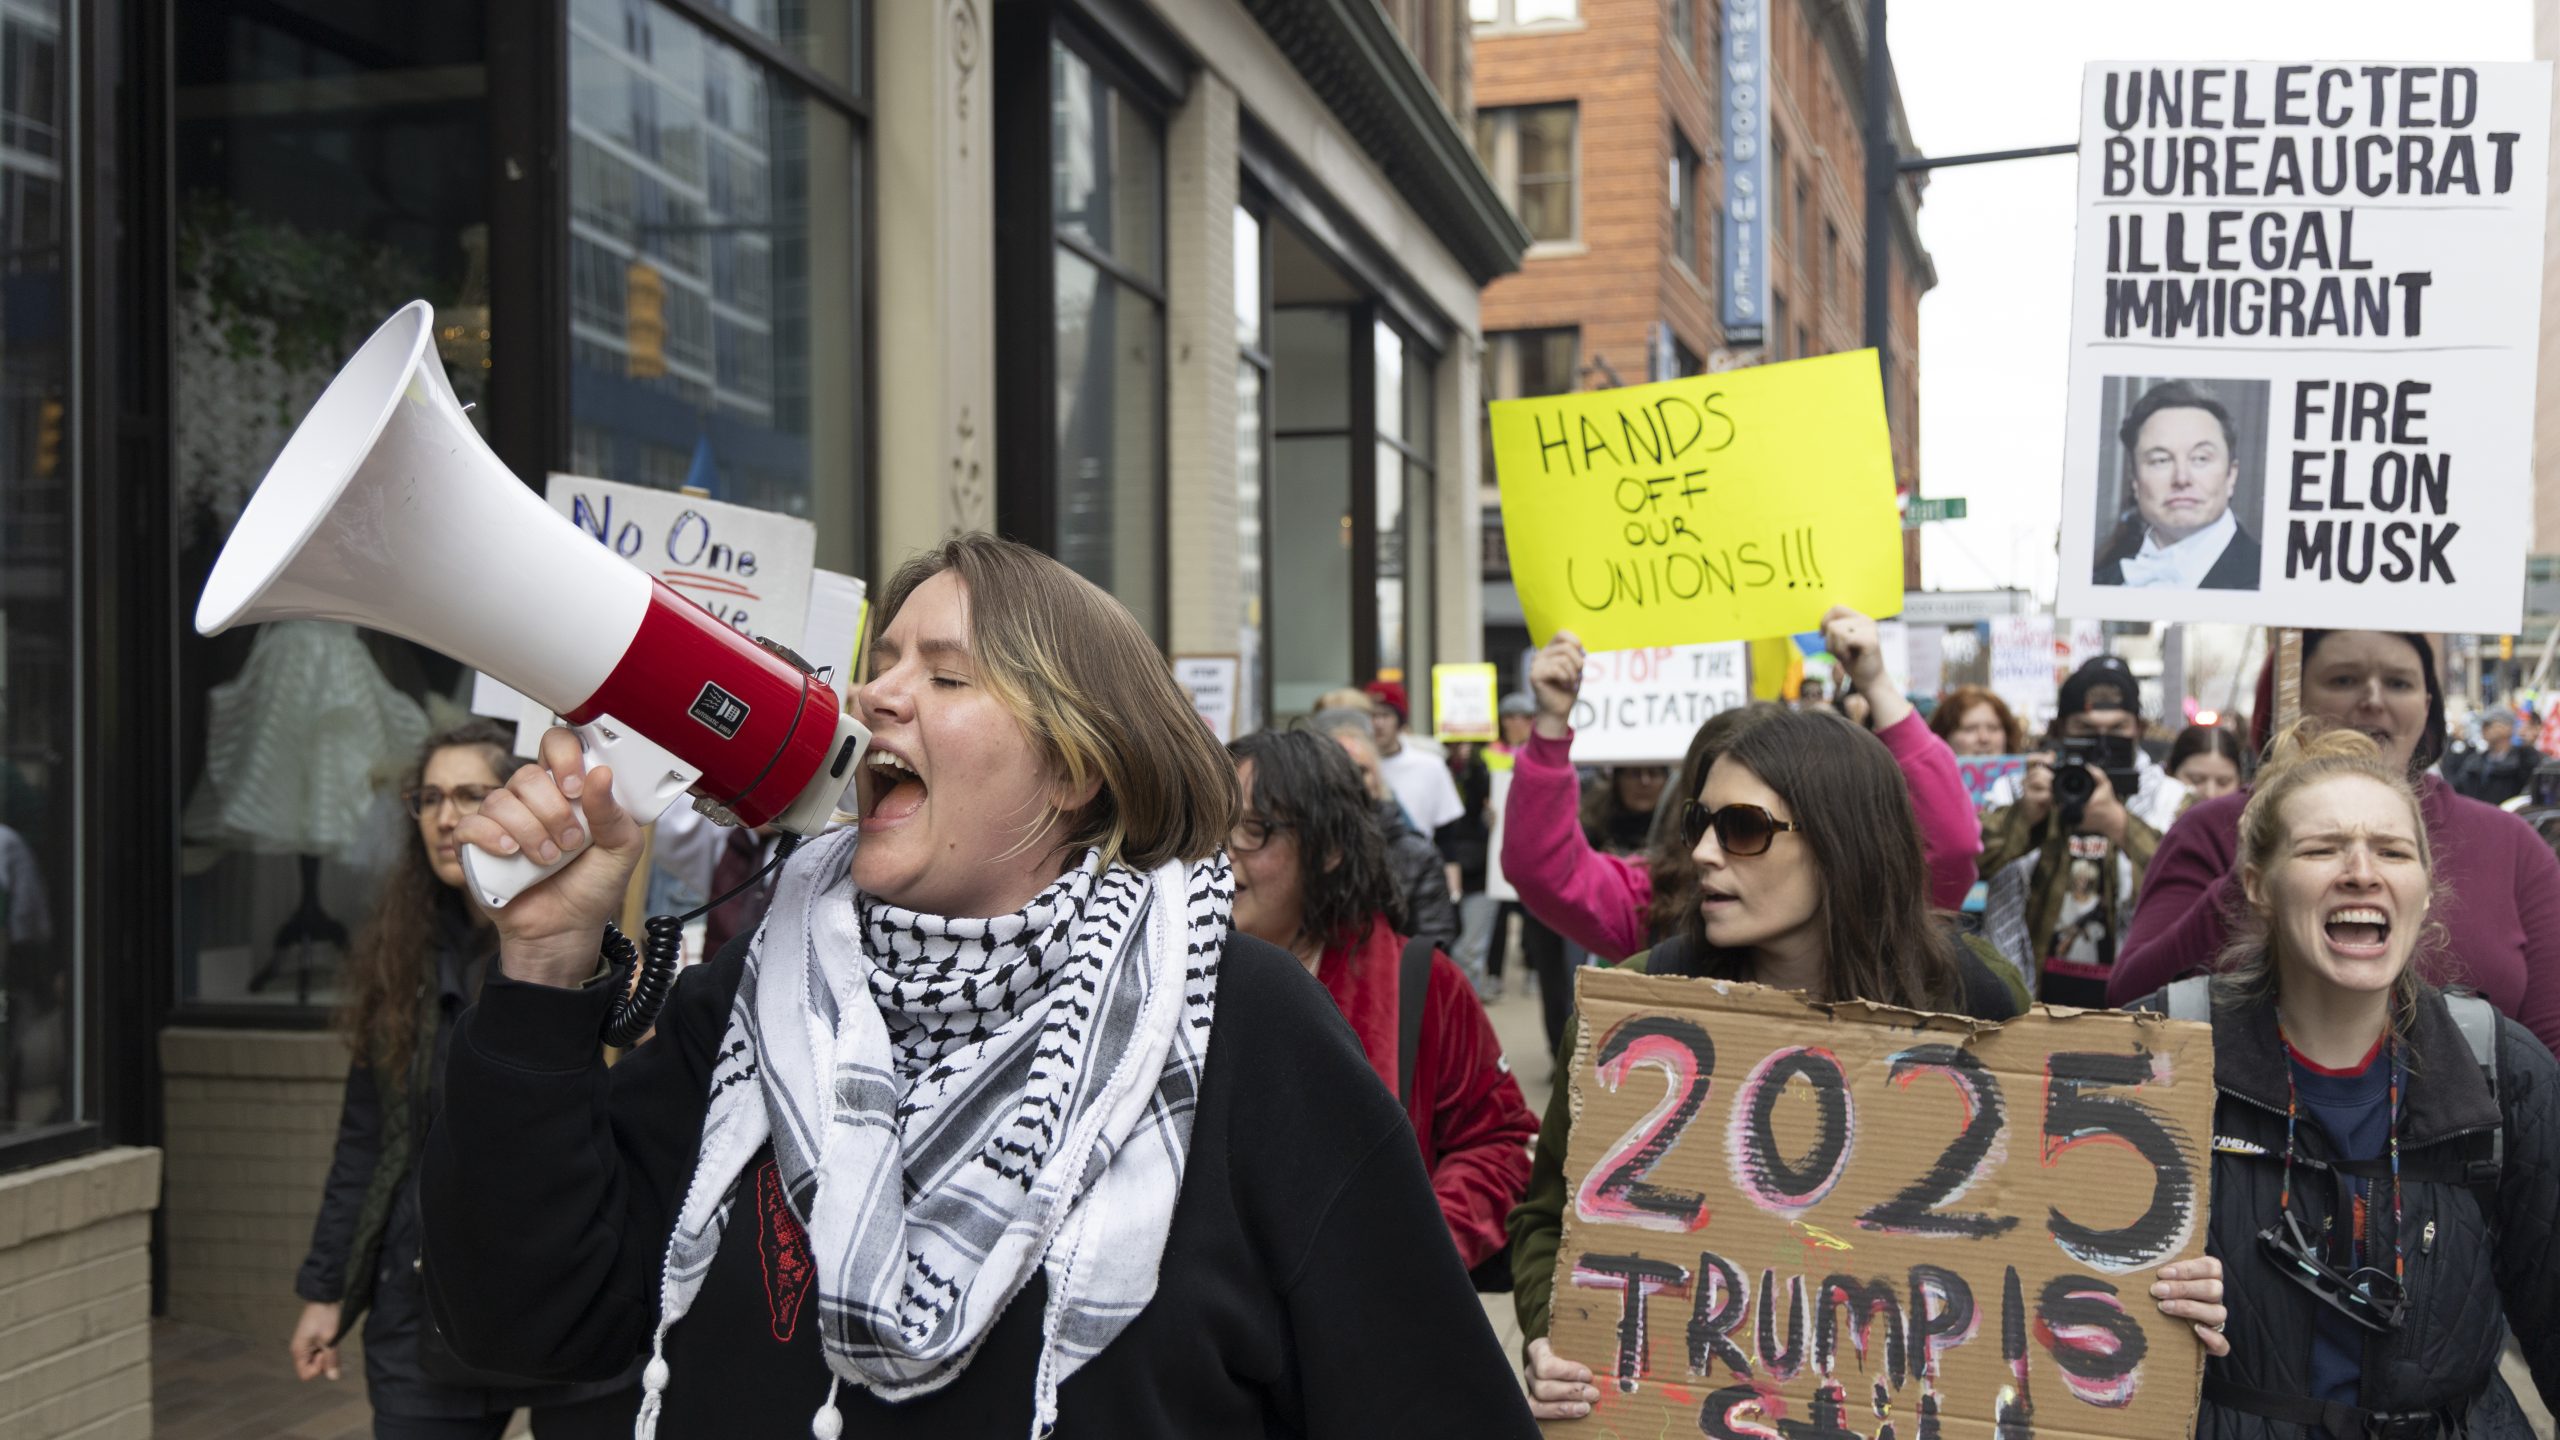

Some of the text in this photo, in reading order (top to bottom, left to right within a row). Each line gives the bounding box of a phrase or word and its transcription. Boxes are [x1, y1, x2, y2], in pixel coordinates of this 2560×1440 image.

[2103, 65, 2478, 131] UNELECTED
[2102, 132, 2520, 198] BUREAUCRAT
[1731, 170, 1757, 319] SUITES
[2106, 207, 2373, 273] ILLEGAL
[2103, 271, 2431, 339] IMMIGRANT
[1535, 391, 1735, 475] HANDS
[2293, 379, 2431, 445] FIRE
[1614, 468, 1708, 513] OFF
[2287, 449, 2451, 514] ELON
[573, 493, 757, 576] No One
[1623, 516, 1702, 547] OUR
[2285, 519, 2460, 585] MUSK
[1567, 527, 1825, 611] UNIONS!!!
[1691, 649, 1738, 679] THE
[1578, 1016, 2196, 1273] 2025
[1572, 1250, 2148, 1408] TRUMP IS
